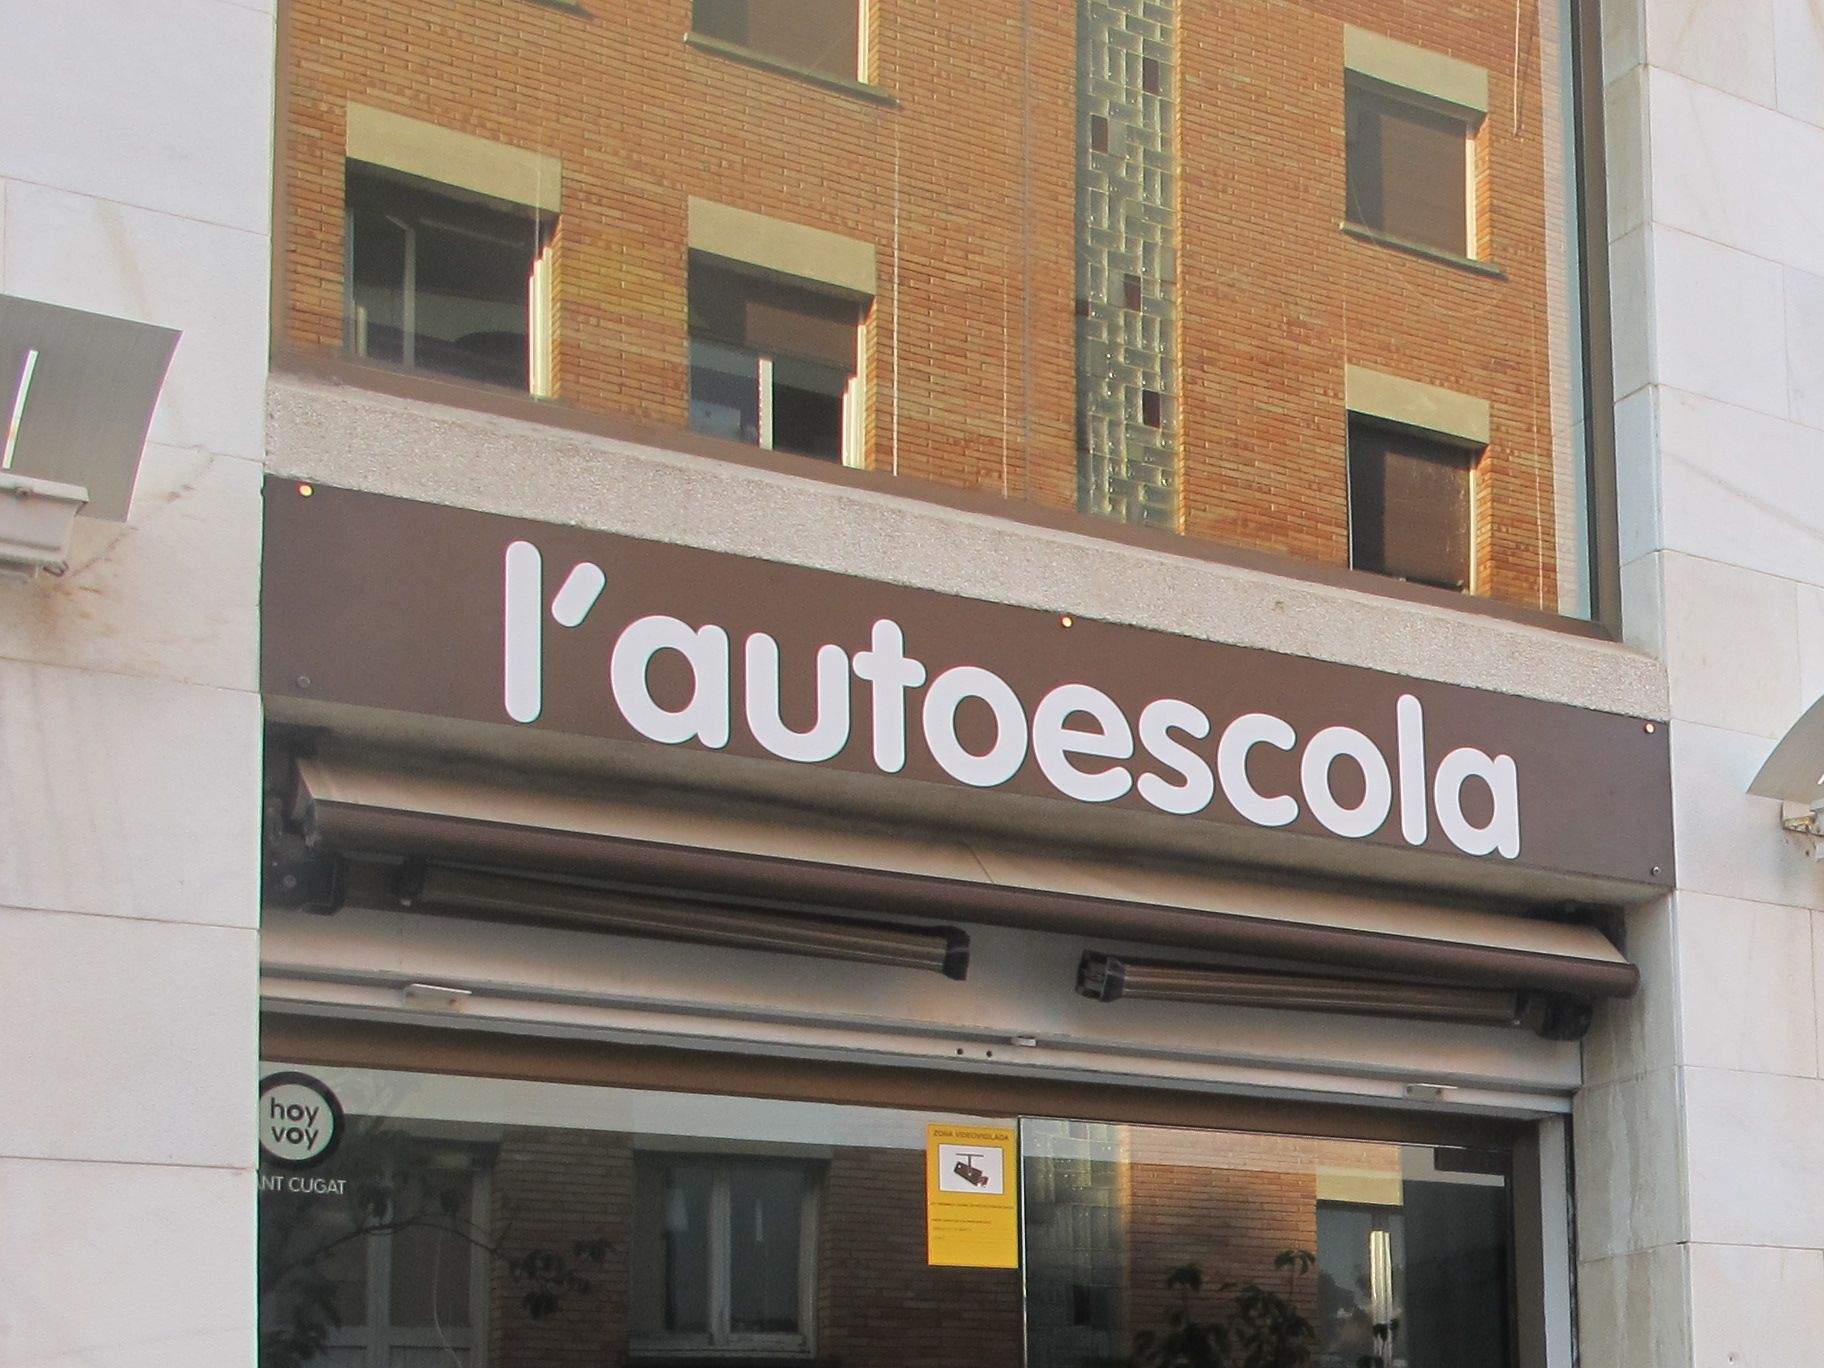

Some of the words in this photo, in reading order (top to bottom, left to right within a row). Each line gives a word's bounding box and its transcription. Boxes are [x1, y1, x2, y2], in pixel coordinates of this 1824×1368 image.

[503, 540, 1523, 861] l'autoescola
[270, 1097, 320, 1127] hoy
[271, 1126, 320, 1151] voy
[259, 1174, 284, 1192] NT
[288, 1176, 347, 1195] CUGAT
